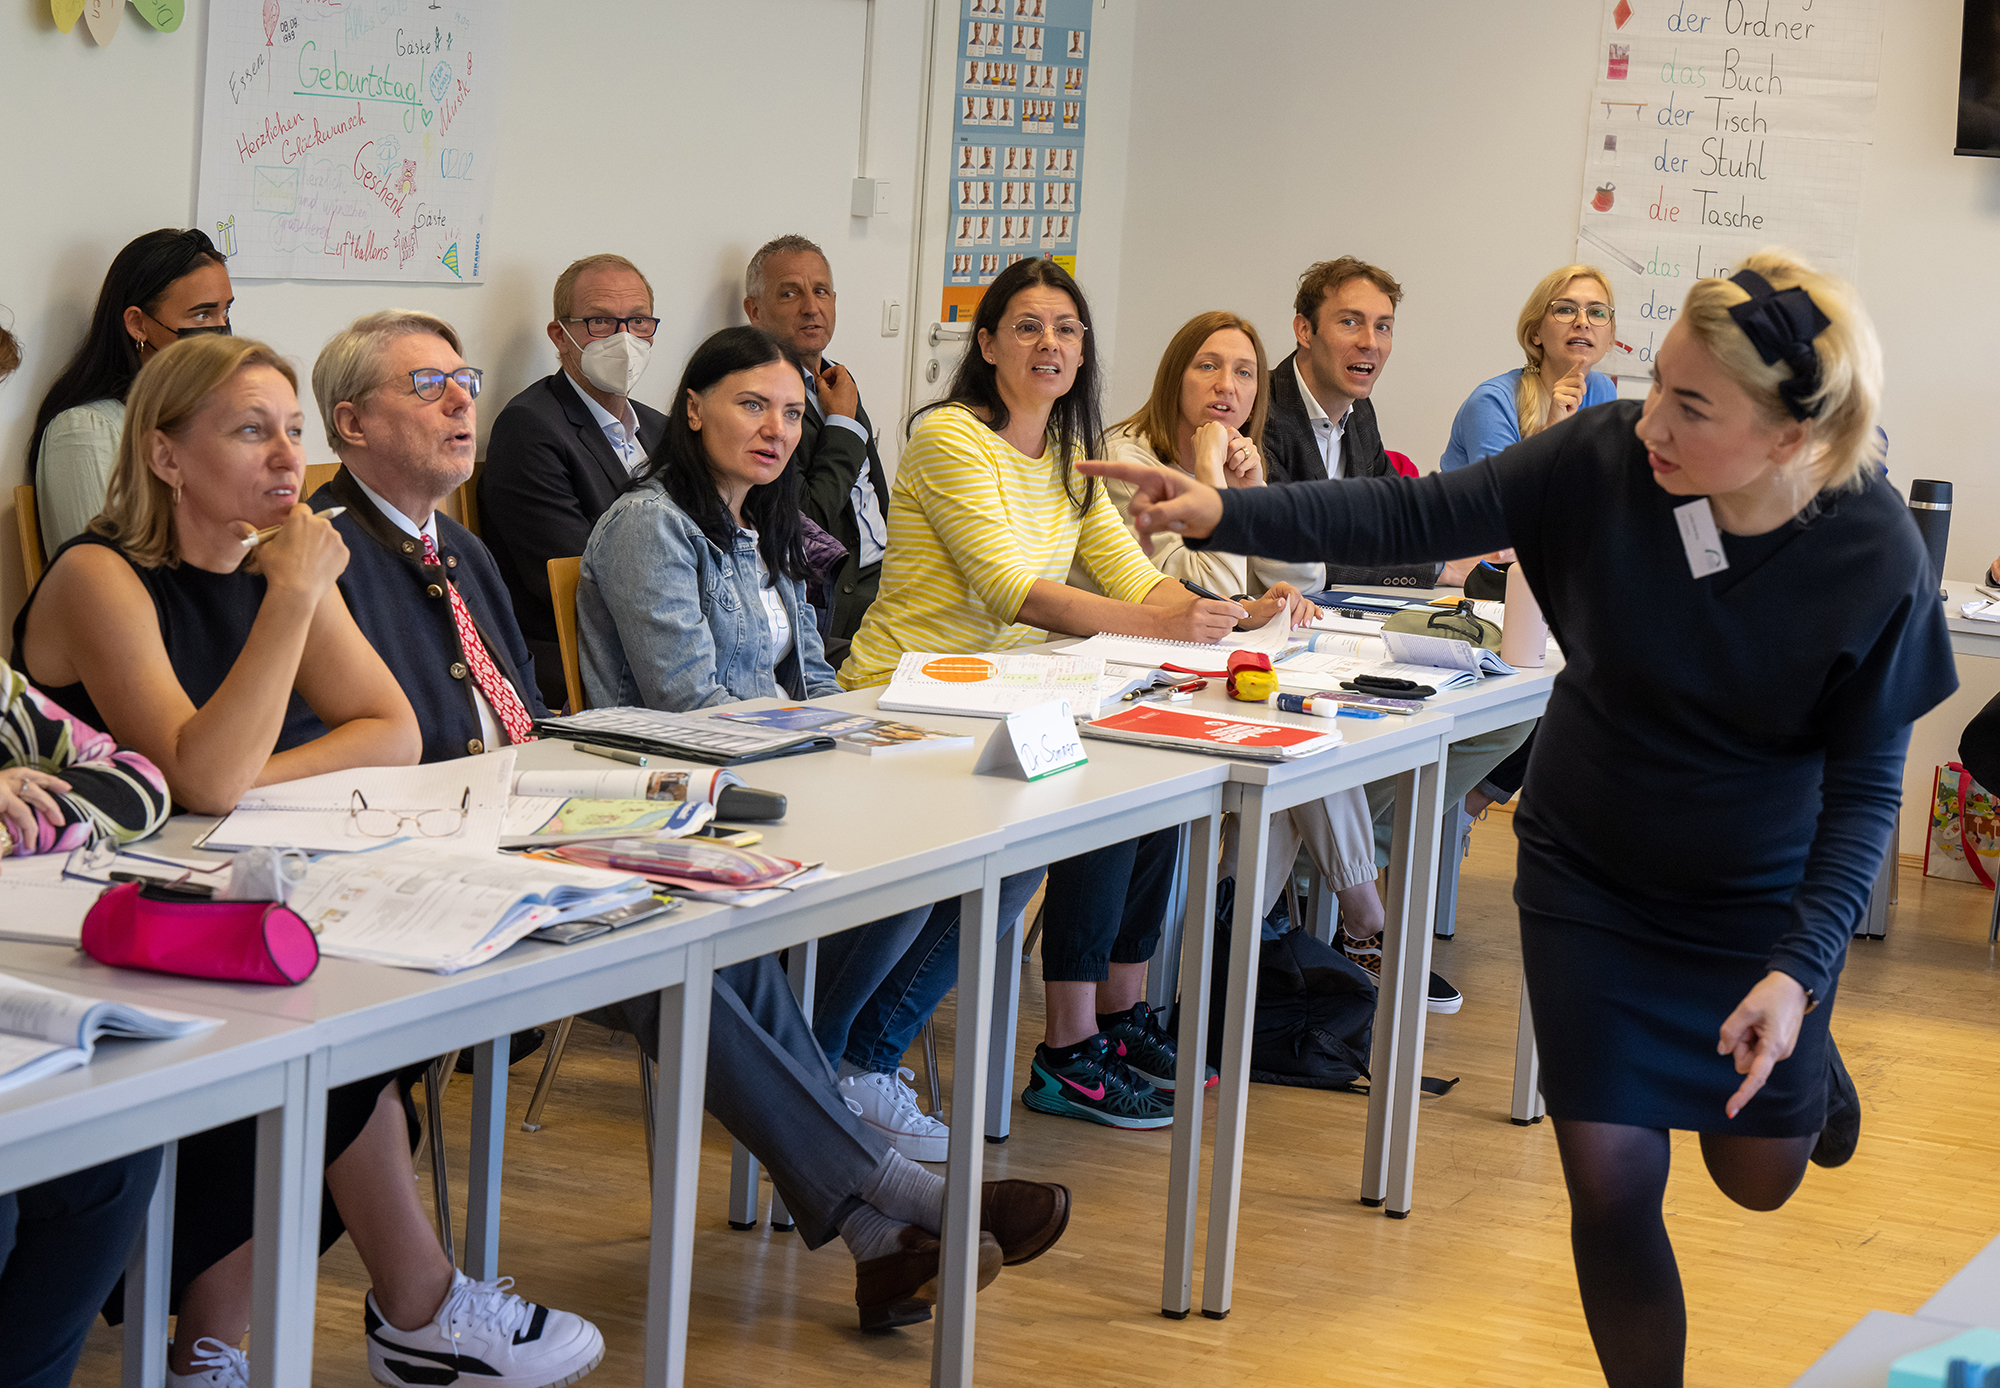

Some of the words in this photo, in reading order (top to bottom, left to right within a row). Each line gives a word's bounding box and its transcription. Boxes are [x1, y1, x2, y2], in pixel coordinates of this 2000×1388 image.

[395, 28, 431, 56] Gäste
[1667, 0, 1711, 33] der
[1724, 0, 1816, 40] Ordner
[229, 54, 265, 104] Essen
[298, 40, 424, 134] Geburtstag!
[1661, 48, 1706, 88] das
[1722, 48, 1783, 95] Buch
[440, 79, 471, 137] Musik
[1658, 91, 1695, 126] der
[1704, 96, 1767, 134] Tisch
[236, 112, 304, 163] Herzlichen
[281, 101, 366, 165] Glückwunsch
[353, 140, 406, 218] Geschenk
[1654, 139, 1689, 173] der
[1700, 136, 1767, 180] Stuhl
[414, 202, 446, 229] Gäste
[1649, 185, 1680, 223] die
[1693, 188, 1764, 230] Tasche
[1646, 246, 1681, 278] das
[1640, 289, 1677, 321] der
